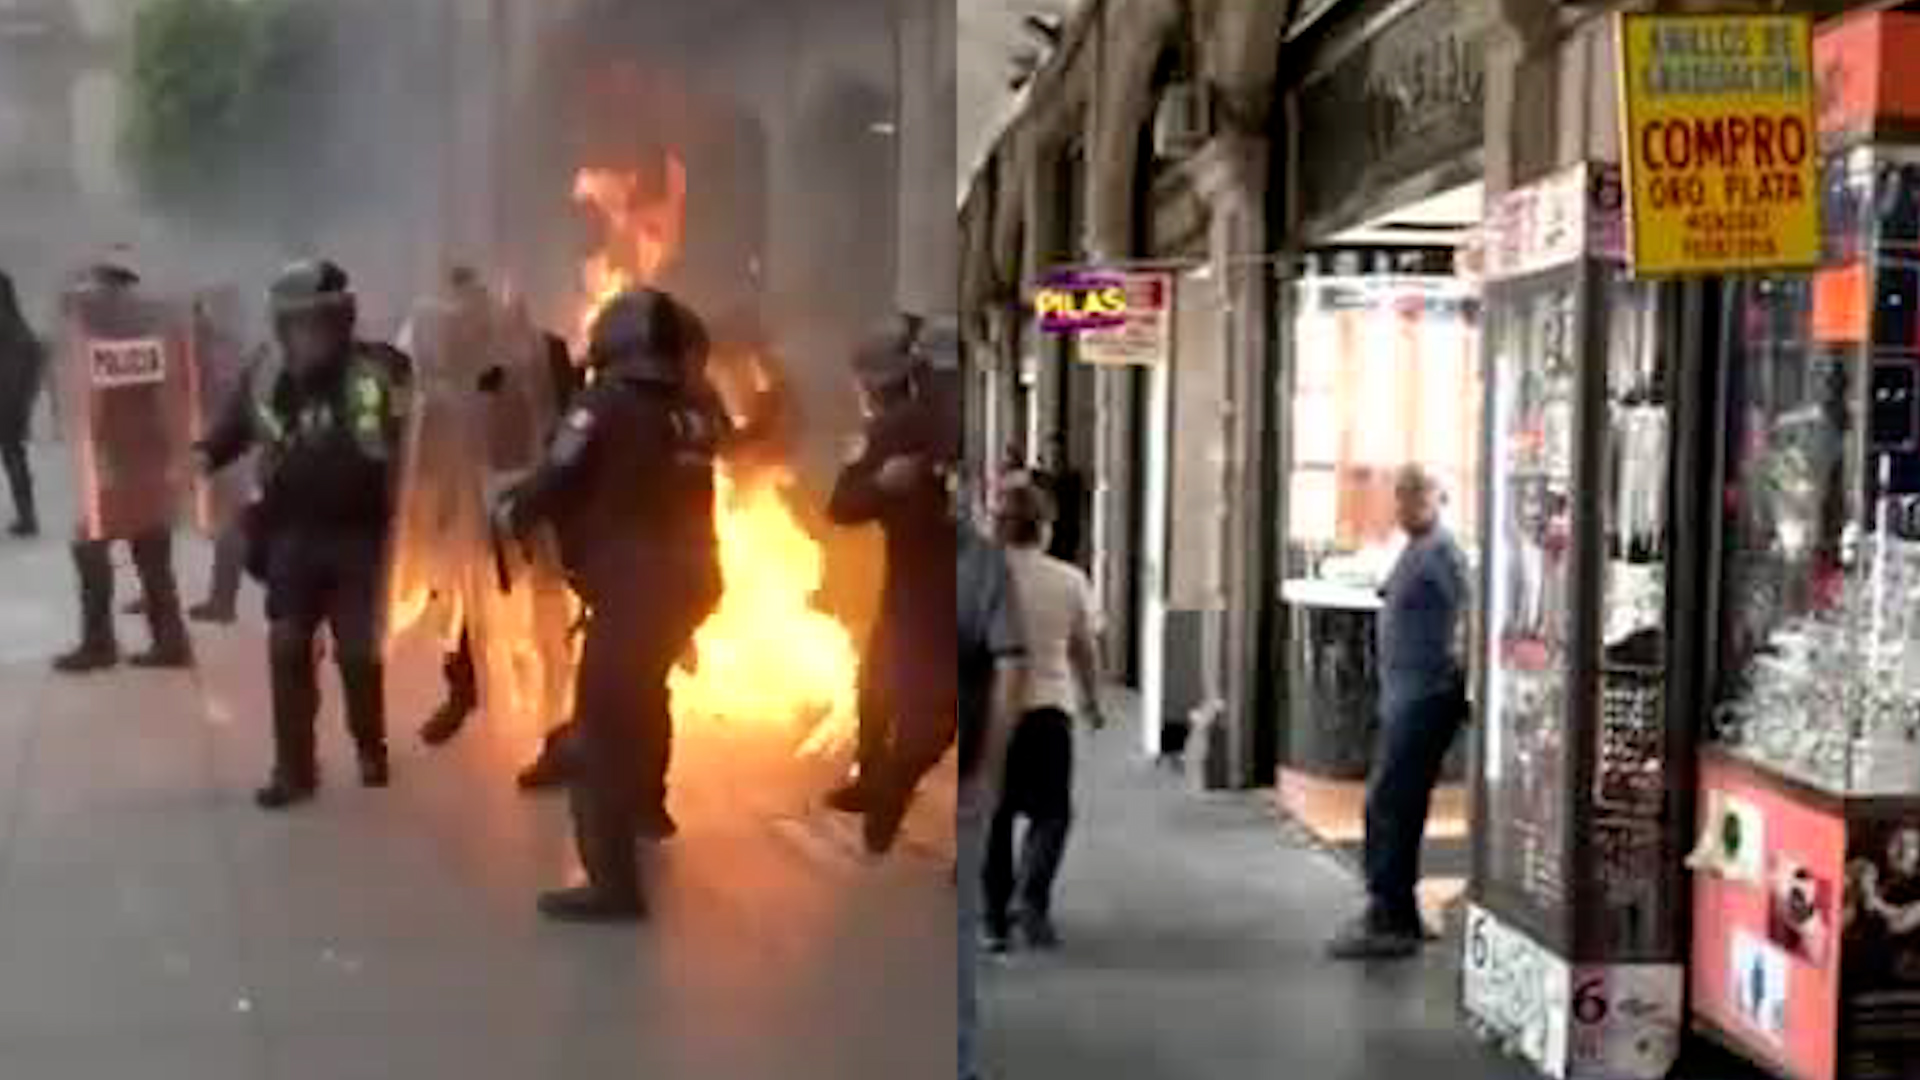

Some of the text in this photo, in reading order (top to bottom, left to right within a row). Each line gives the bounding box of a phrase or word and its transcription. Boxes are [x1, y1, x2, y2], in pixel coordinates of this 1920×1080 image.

[1642, 113, 1806, 171] COMPRO
[1649, 172, 1803, 209] ORO PLATA
[1035, 286, 1126, 319] PILAS
[94, 346, 159, 376] POLICIA
[1573, 977, 1607, 1025] 6
